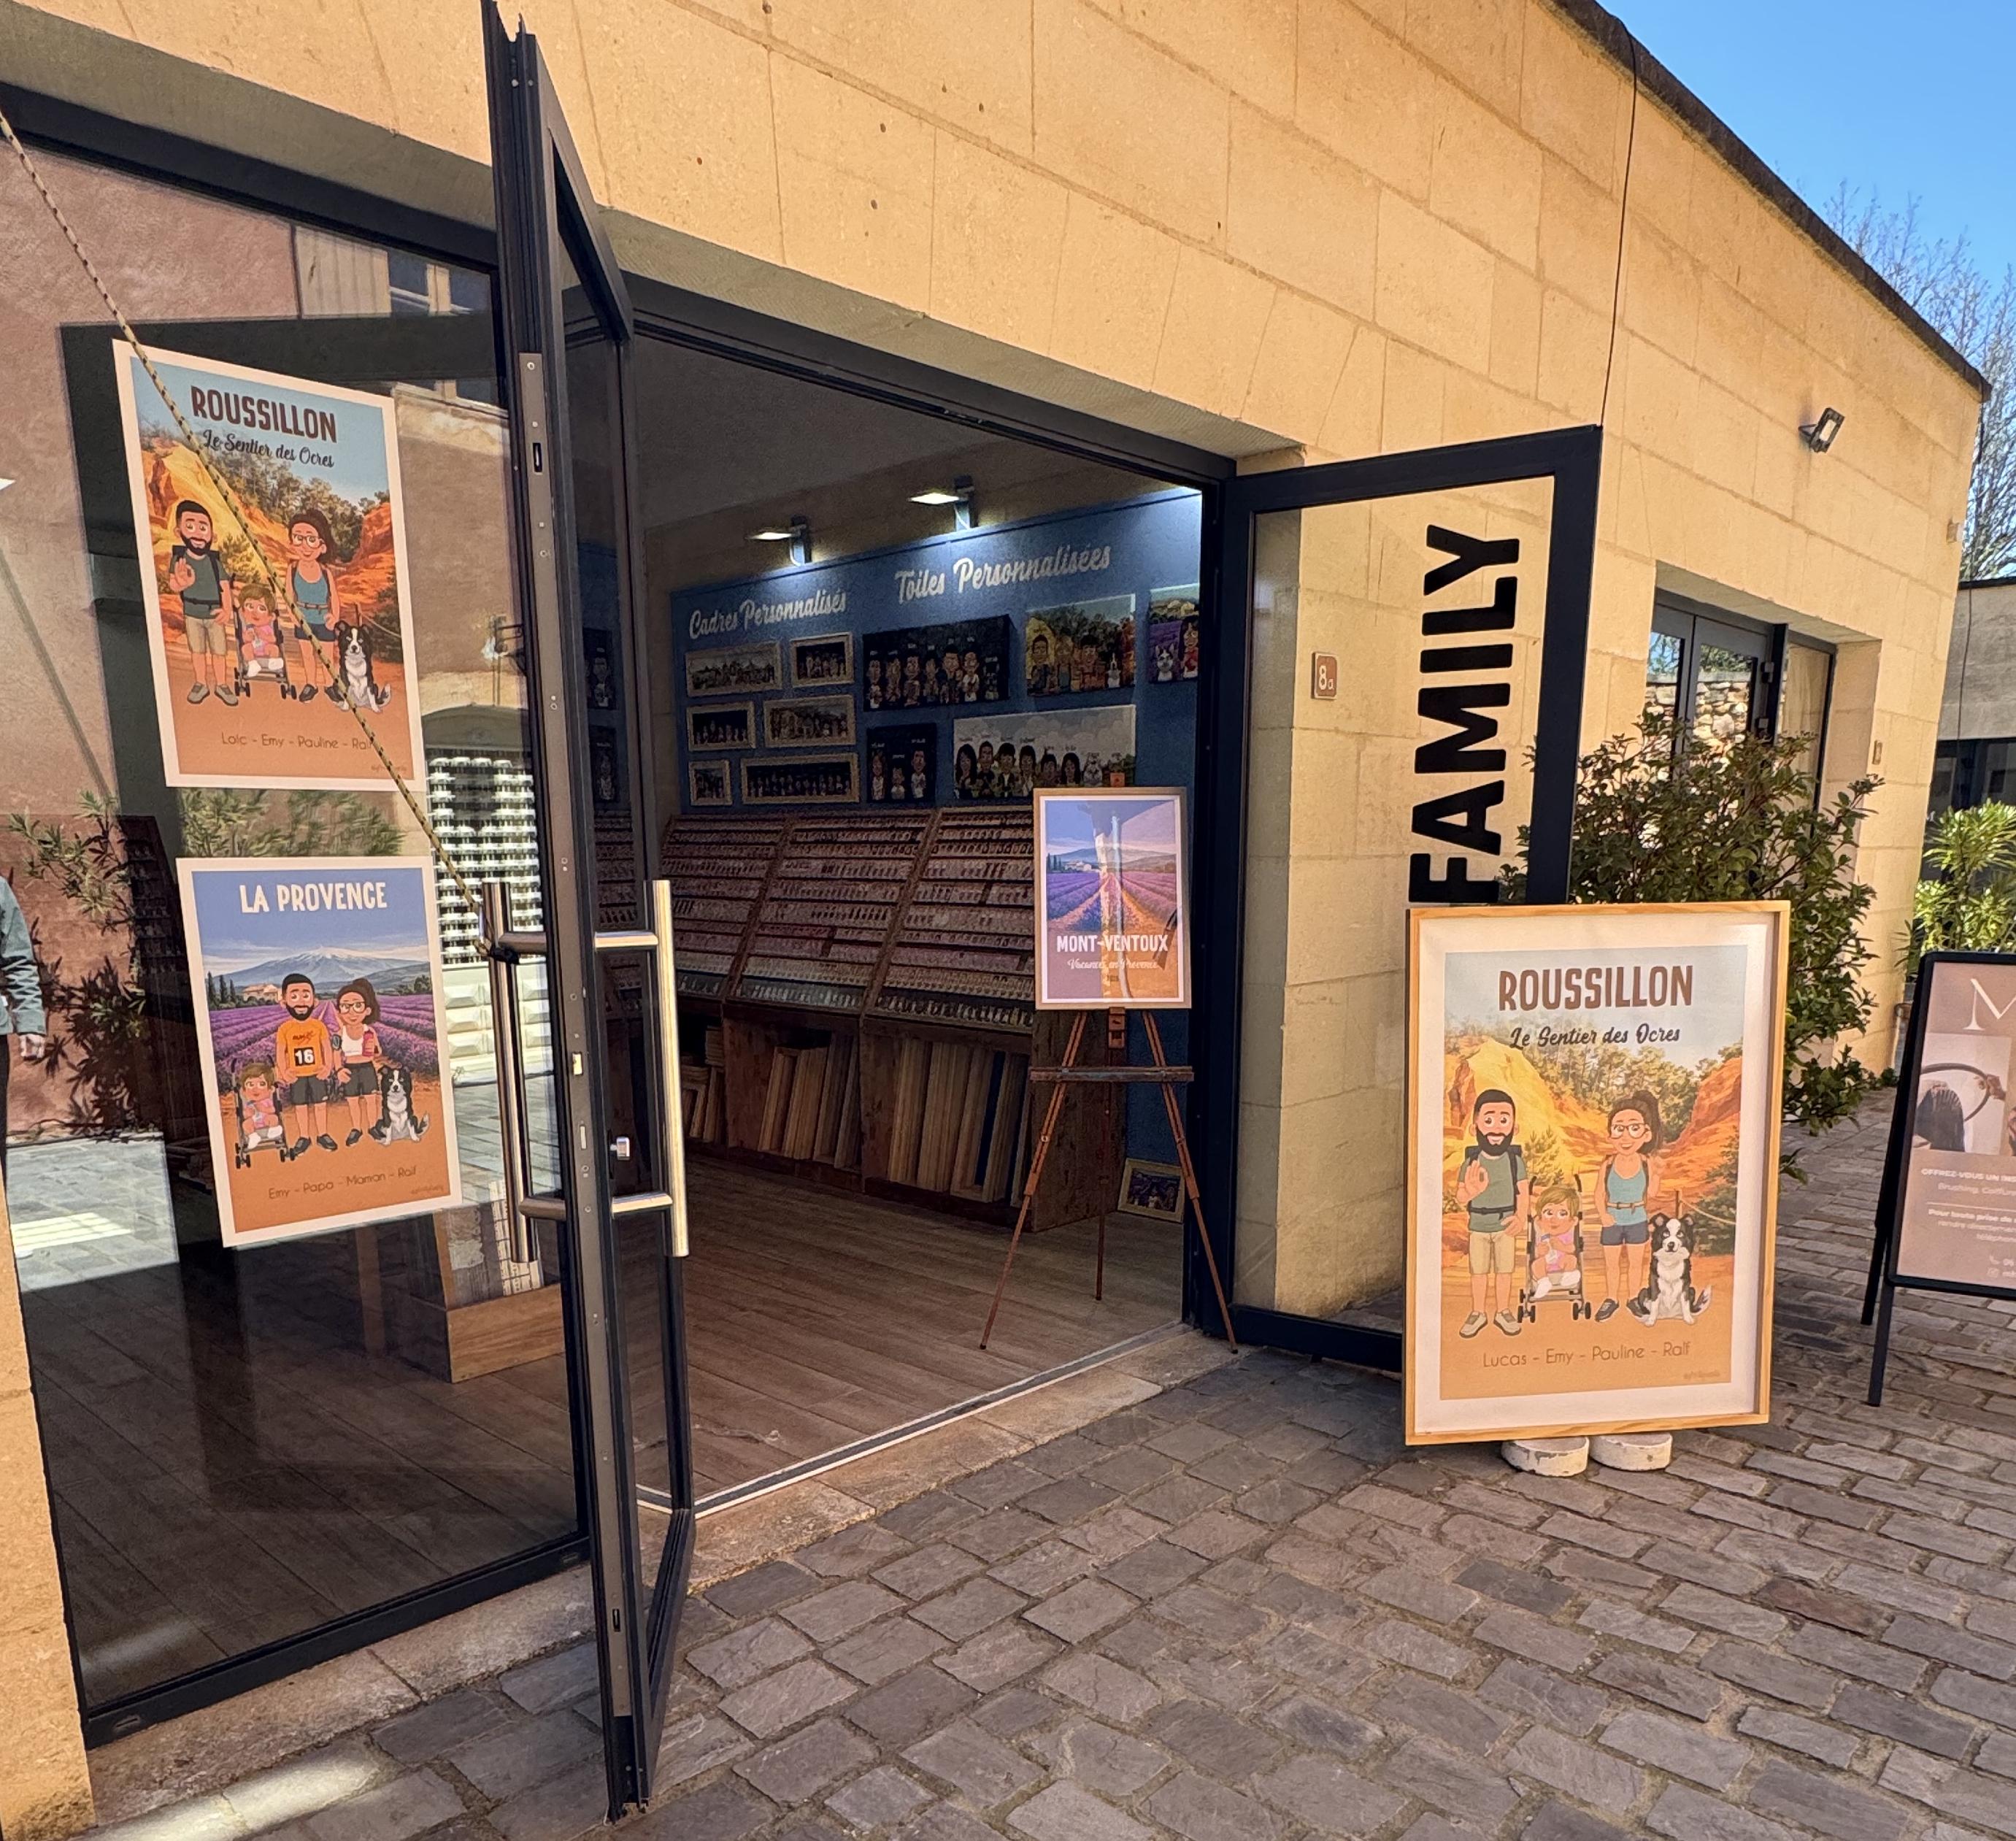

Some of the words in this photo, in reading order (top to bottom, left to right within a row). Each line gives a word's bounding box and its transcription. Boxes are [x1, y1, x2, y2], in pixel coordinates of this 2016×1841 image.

[191, 385, 337, 443] ROUSSILLON
[203, 429, 220, 451] Le
[224, 433, 272, 457] Sentier
[276, 444, 296, 461] des
[299, 447, 334, 468] Ocres
[895, 569, 945, 604] Toiles
[953, 545, 1112, 593] Personnalisées
[689, 610, 739, 639] Cadres
[739, 588, 847, 631] Personnalisés
[1408, 524, 1520, 903] FAMILY
[261, 734, 284, 747] Emy
[298, 735, 339, 749] Pauline
[239, 885, 270, 913] LA
[276, 881, 388, 912] PROVENCE
[1056, 934, 1168, 953] MONT-VENTOUX
[1498, 964, 1693, 1012] ROUSSILLON
[1509, 1026, 1531, 1050] Le
[1538, 1025, 1598, 1048] Sentier
[1603, 1026, 1628, 1044] des
[1636, 1023, 1680, 1044] Ocres
[294, 1049, 314, 1065] 16
[268, 1188, 291, 1200] Emy
[303, 1181, 334, 1194] Papa
[346, 1173, 386, 1187] Maman
[1483, 1352, 1527, 1367] Lucas
[1545, 1348, 1574, 1365] Emy
[1591, 1345, 1645, 1361] Pauline
[1663, 1341, 1692, 1356] Ralf
